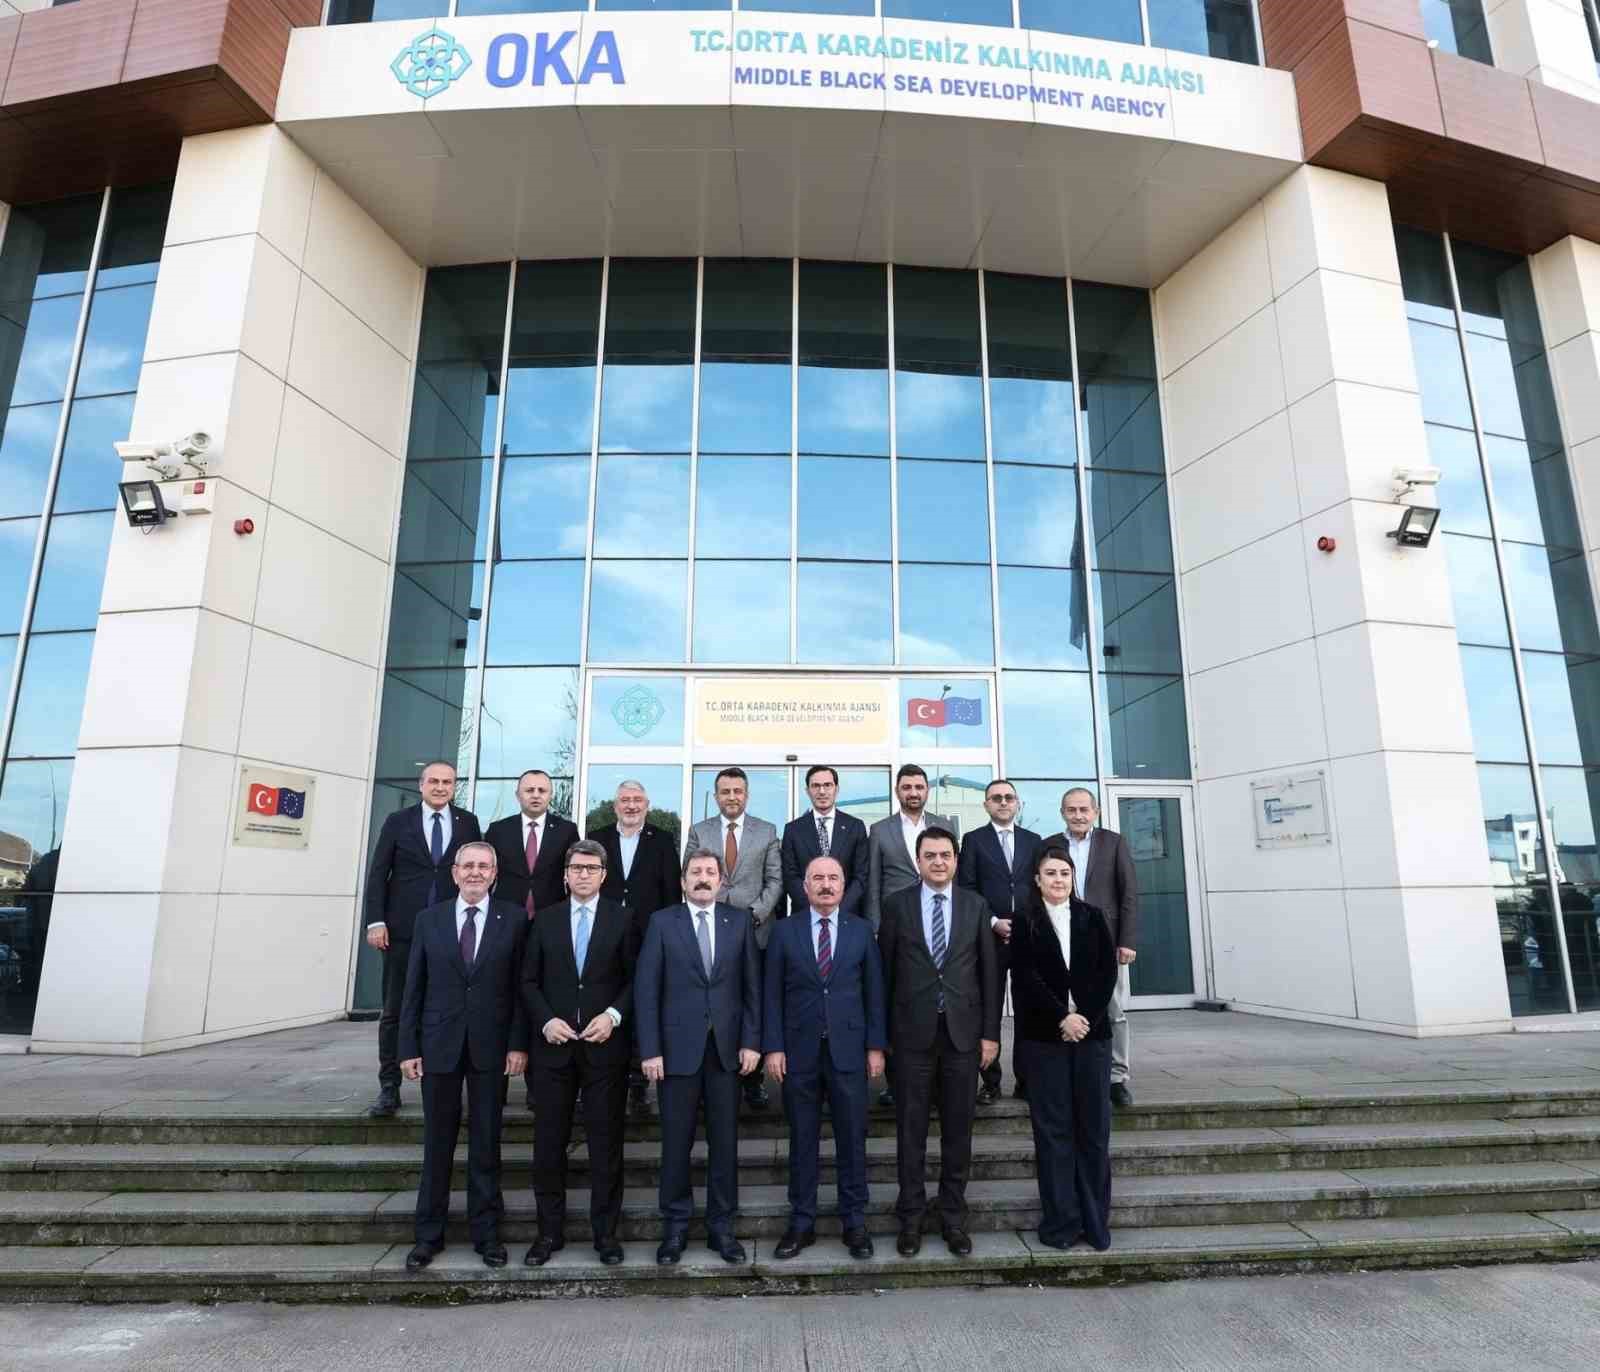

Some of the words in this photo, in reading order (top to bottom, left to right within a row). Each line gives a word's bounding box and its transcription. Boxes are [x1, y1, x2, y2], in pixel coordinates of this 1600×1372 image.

[486, 30, 626, 88] OKA
[817, 33, 969, 65] KARADENİZ
[978, 44, 1113, 81] KALKINMA
[1120, 62, 1206, 96] AJANSI
[734, 67, 812, 87] MIDDLE
[820, 71, 887, 91] BLACK
[893, 74, 934, 94] SEA
[940, 78, 1085, 109] DEVELOPMENT
[1091, 94, 1167, 119] AGENCY
